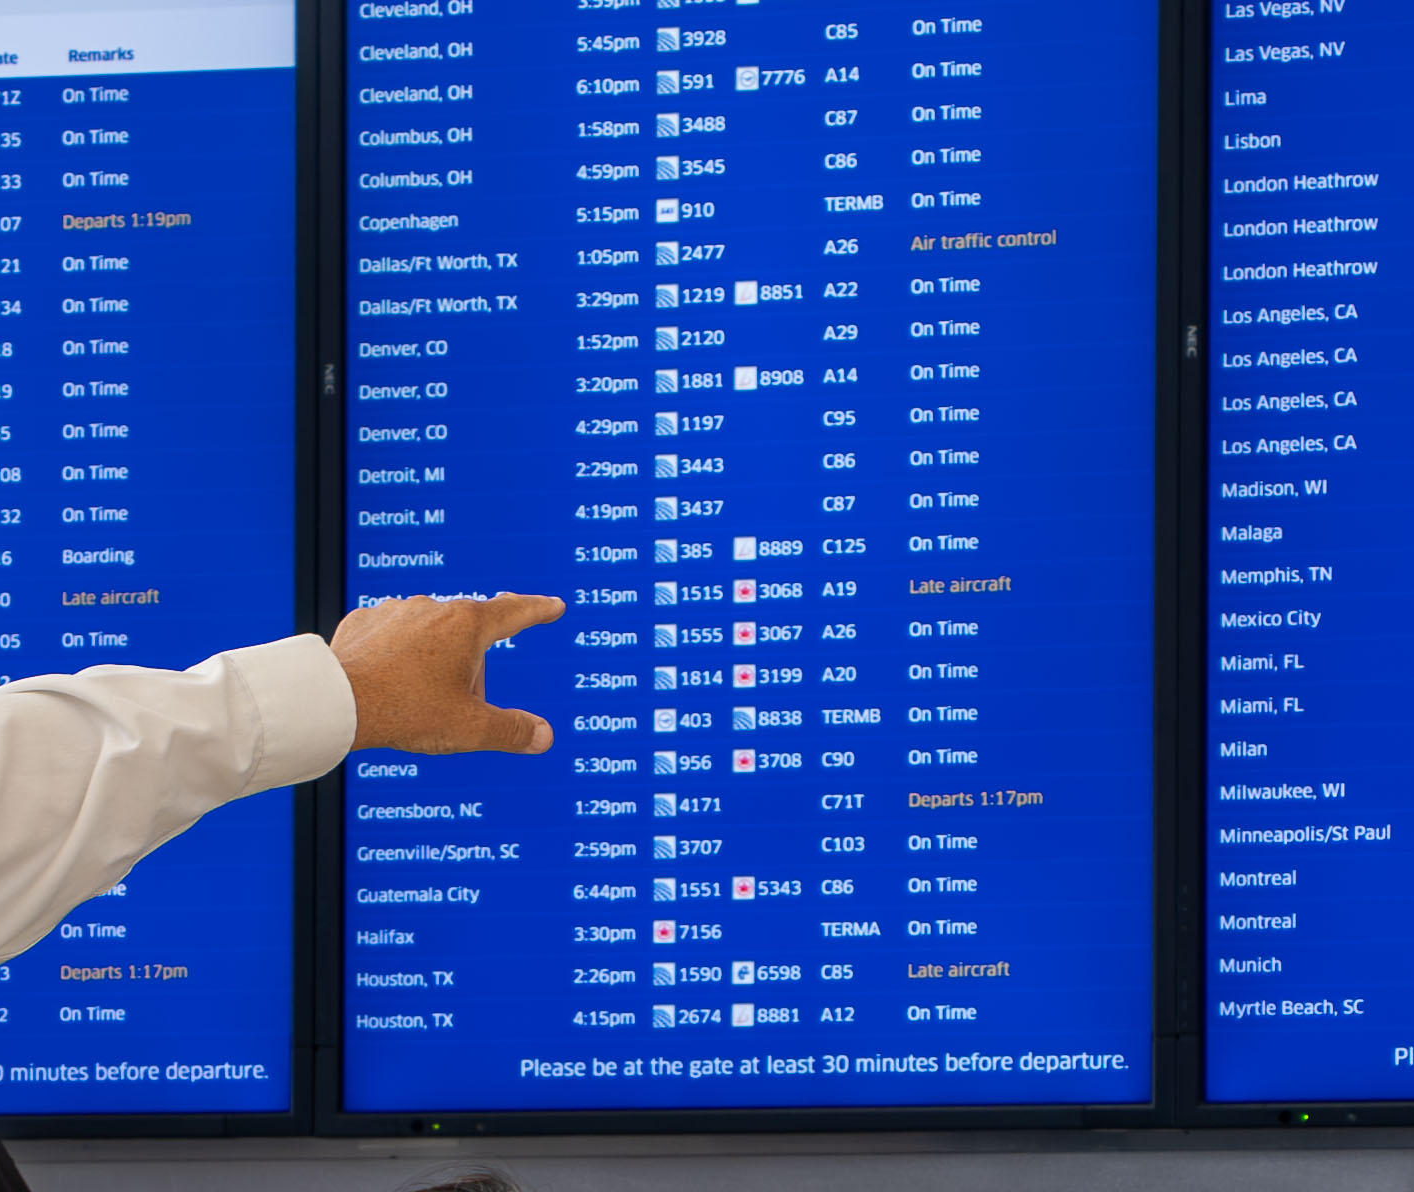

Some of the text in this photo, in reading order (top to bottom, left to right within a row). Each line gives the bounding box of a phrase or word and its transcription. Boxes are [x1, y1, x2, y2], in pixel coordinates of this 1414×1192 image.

[359, 16, 983, 62] Cleveland, OH 5:45pm 3928 C85 On Time
[67, 46, 135, 63] Remarks
[62, 87, 85, 104] On
[90, 84, 129, 102] Time
[61, 129, 86, 147] On
[88, 128, 130, 145] Time
[1224, 132, 1282, 151] Lisbon
[62, 213, 126, 231] Departs
[131, 211, 192, 228] 1:19pm
[359, 229, 1057, 274] Dallas/Ft Worth, TX 1:05pm 2477 A26 Air traffic control
[1222, 309, 1253, 325] Los
[1256, 304, 1330, 326] Angeles,
[1334, 303, 1359, 320] CA
[62, 547, 135, 566] Boarding
[358, 534, 980, 569] Dubrovnik 5:10pm 385 8889 C125 On Time
[61, 591, 97, 606] Late
[100, 588, 159, 605] aircraft
[357, 789, 1044, 820] Greensboro, NC 1:29pm 4171 C71T Departs 1:17pm
[1219, 825, 1349, 845] Minneapolis/St
[1354, 823, 1391, 841] Paul
[356, 876, 978, 905] Guatemala City 6:44pm 1551 5343 C86 On Time
[1219, 999, 1277, 1020] Myrtle
[1281, 999, 1338, 1017] Beach,
[1342, 998, 1365, 1015] SC
[10, 1063, 89, 1081] minutes
[95, 1062, 160, 1080] before
[165, 1062, 270, 1083] departure.
[520, 1051, 1129, 1079] Please be at the gate at least 30 minutes before departure.
